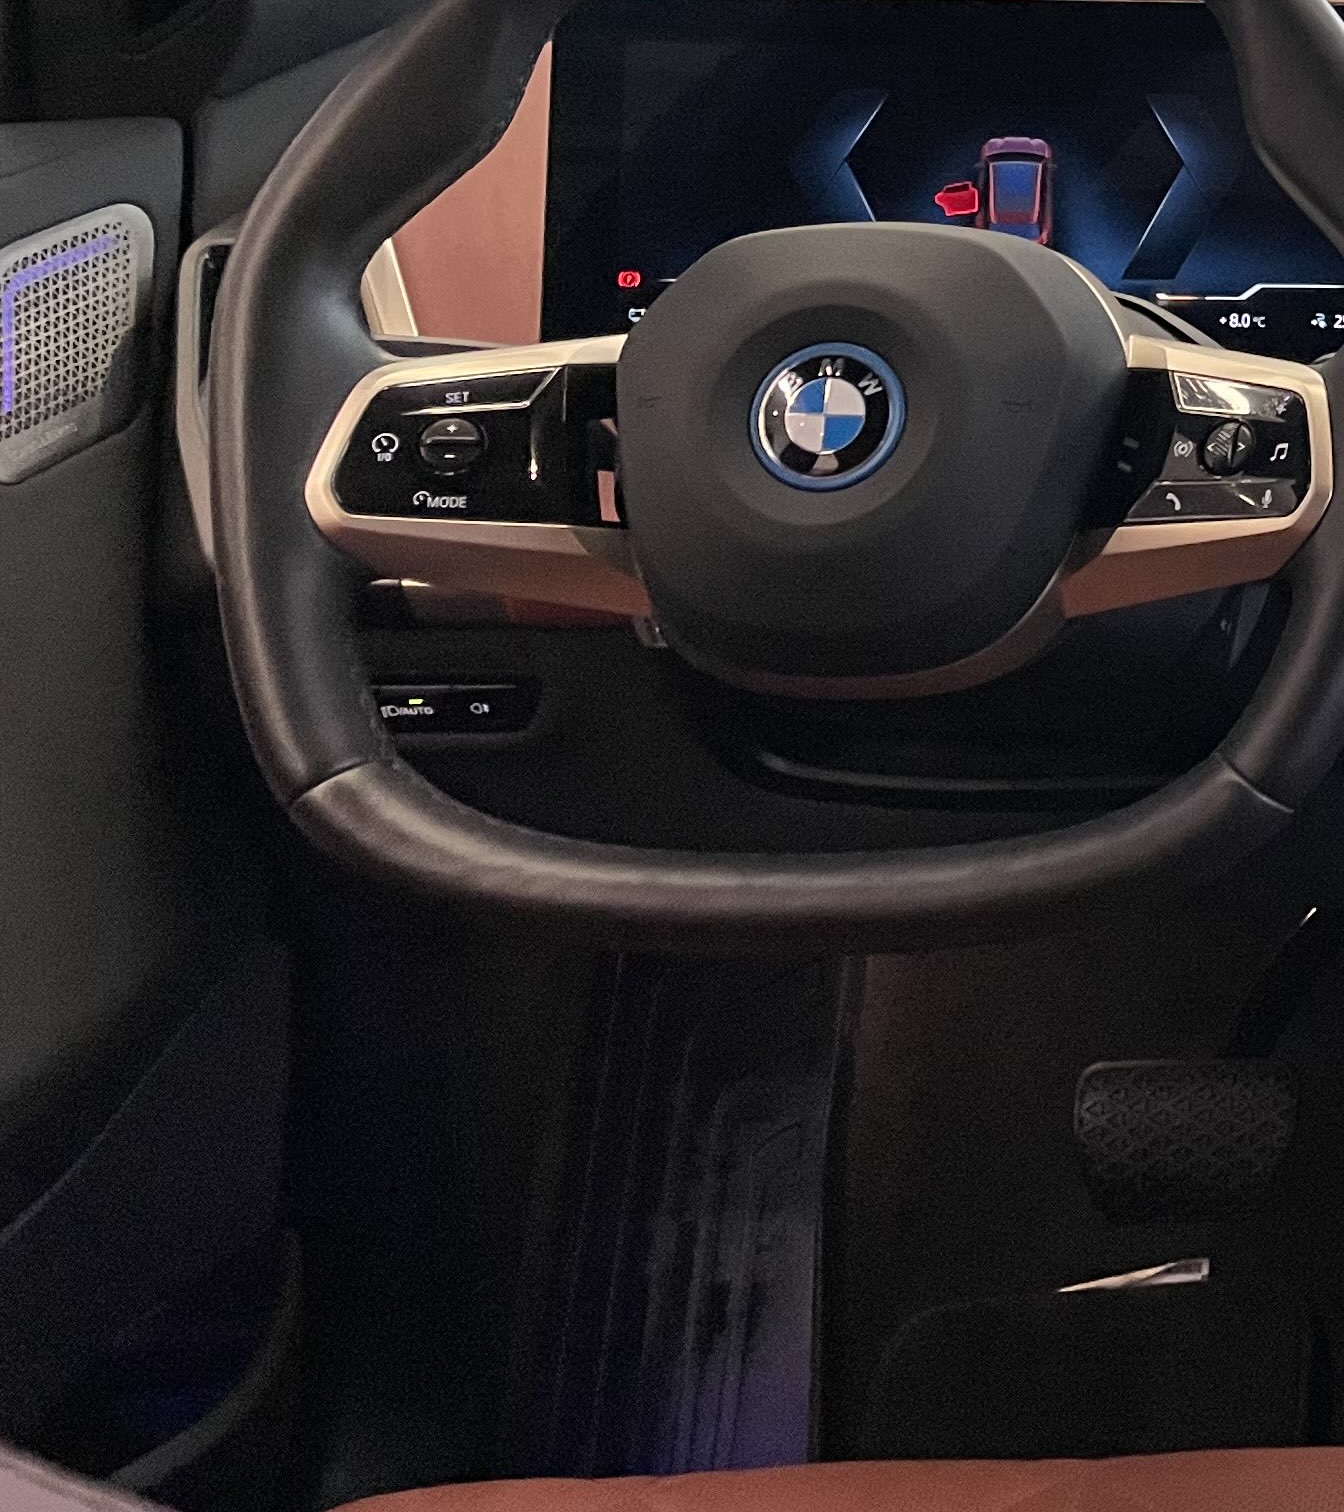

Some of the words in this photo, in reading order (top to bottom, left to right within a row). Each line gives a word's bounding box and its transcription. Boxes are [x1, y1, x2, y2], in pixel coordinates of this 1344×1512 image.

[777, 357, 883, 401] BMW
[445, 391, 470, 404] SET
[426, 496, 467, 508] MODE
